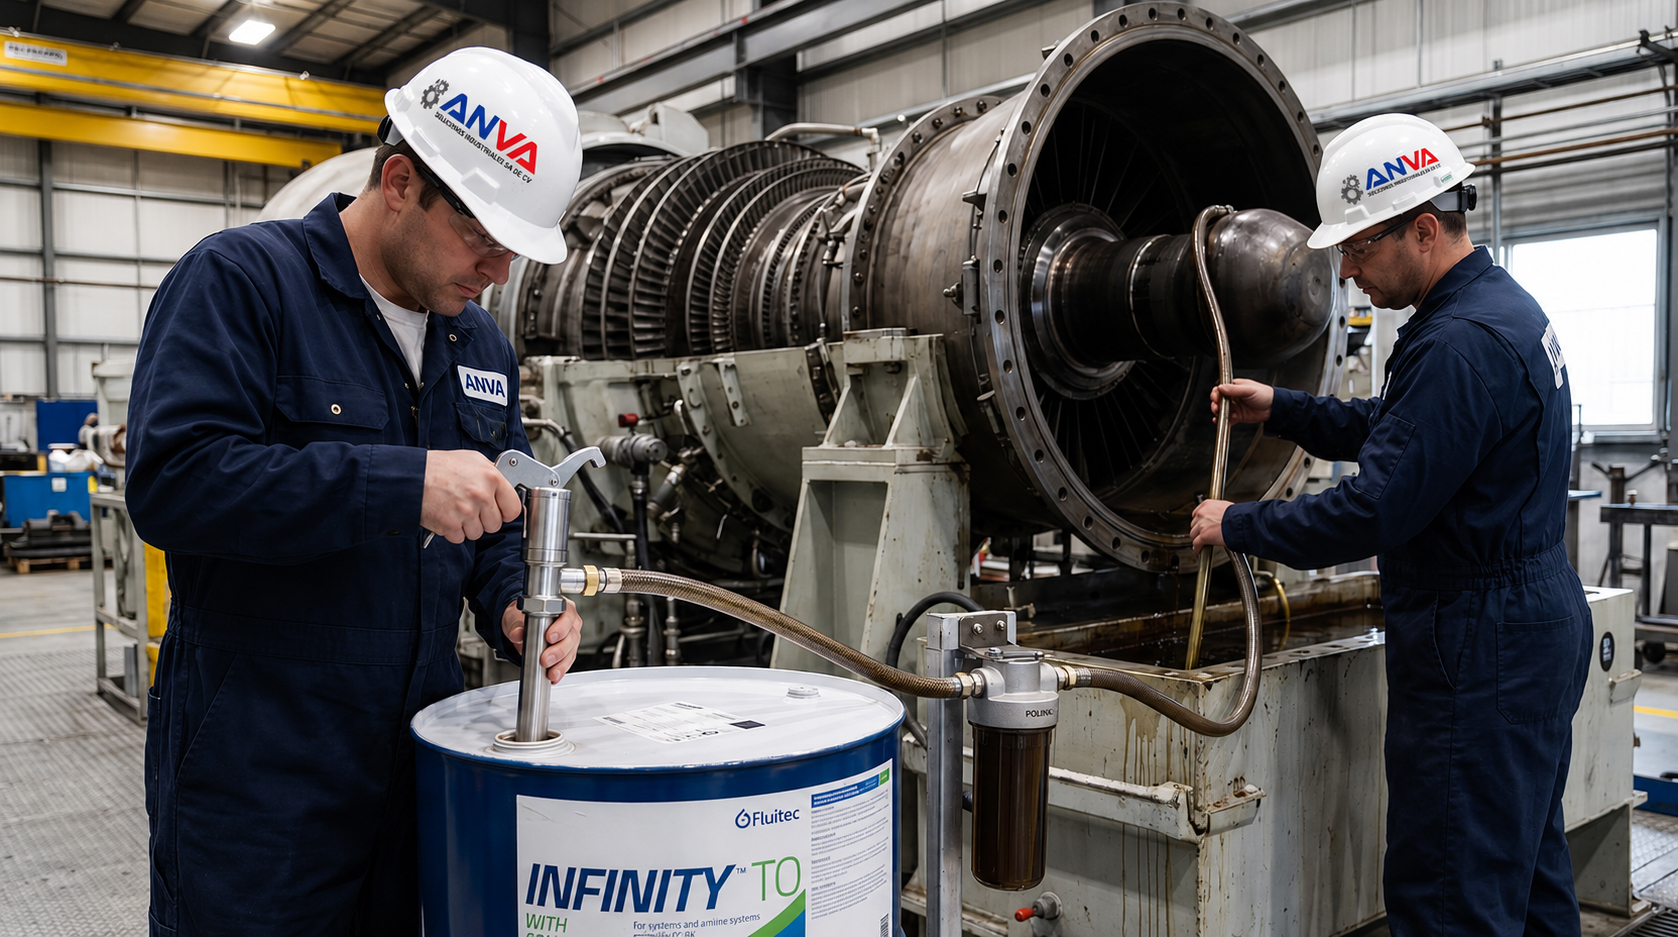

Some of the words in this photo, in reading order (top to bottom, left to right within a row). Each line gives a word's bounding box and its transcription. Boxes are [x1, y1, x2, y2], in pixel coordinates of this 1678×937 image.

[439, 93, 538, 175] ANVA
[1366, 147, 1440, 191] ANVA
[465, 373, 506, 398] ANVA
[752, 808, 800, 827] Fluitec
[525, 863, 737, 913] INFINITY
[751, 856, 801, 901] TO
[526, 912, 568, 933] WITH
[633, 921, 646, 930] For
[683, 919, 699, 929] and
[729, 913, 761, 926] systems
